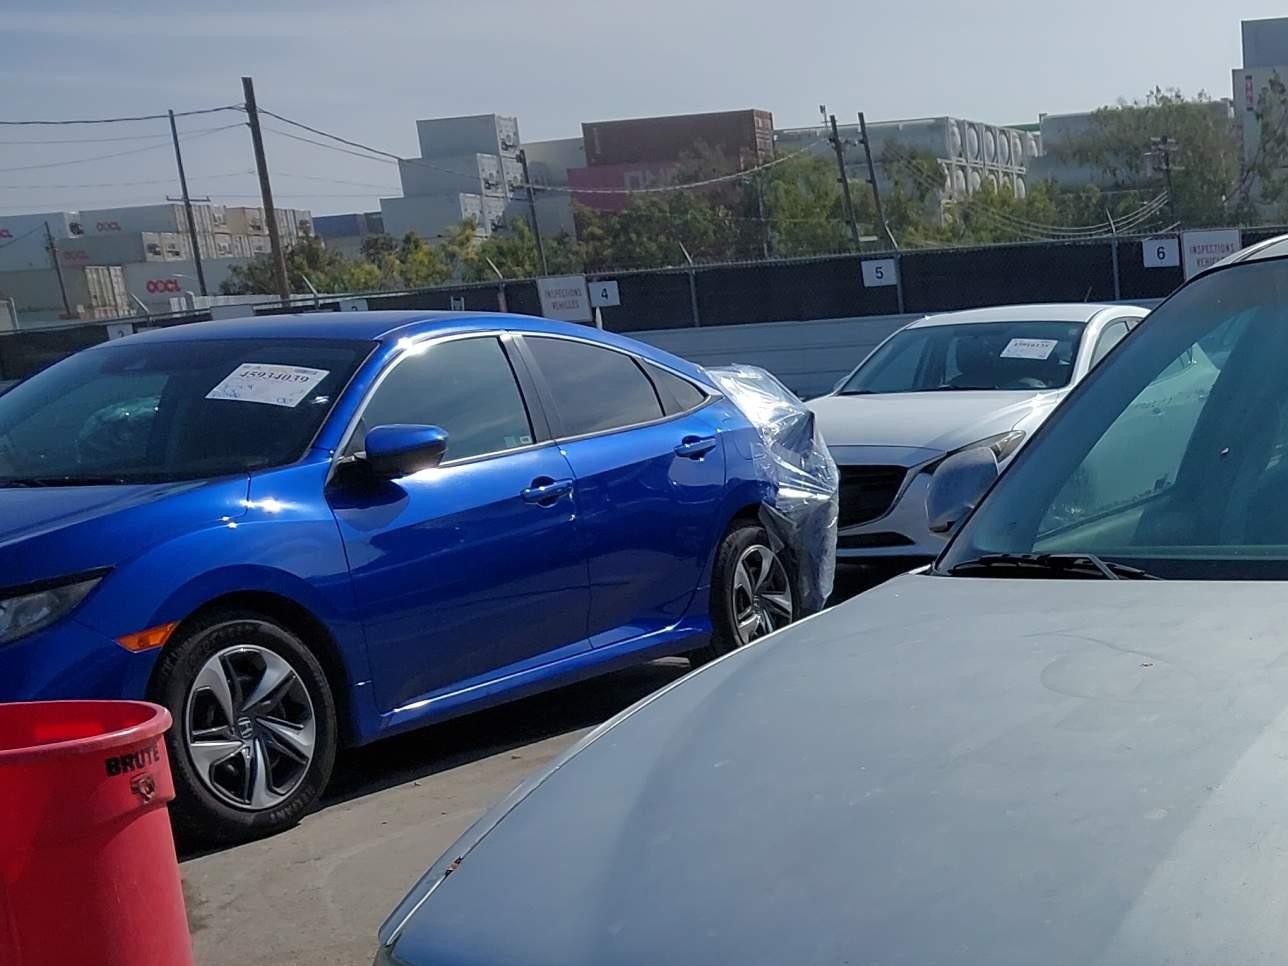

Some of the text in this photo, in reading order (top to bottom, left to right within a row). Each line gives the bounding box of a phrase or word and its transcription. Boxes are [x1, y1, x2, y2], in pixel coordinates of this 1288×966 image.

[1156, 246, 1166, 261] 6
[875, 266, 884, 280] 5
[600, 287, 609, 300] 4
[105, 745, 160, 777] BRUTE
